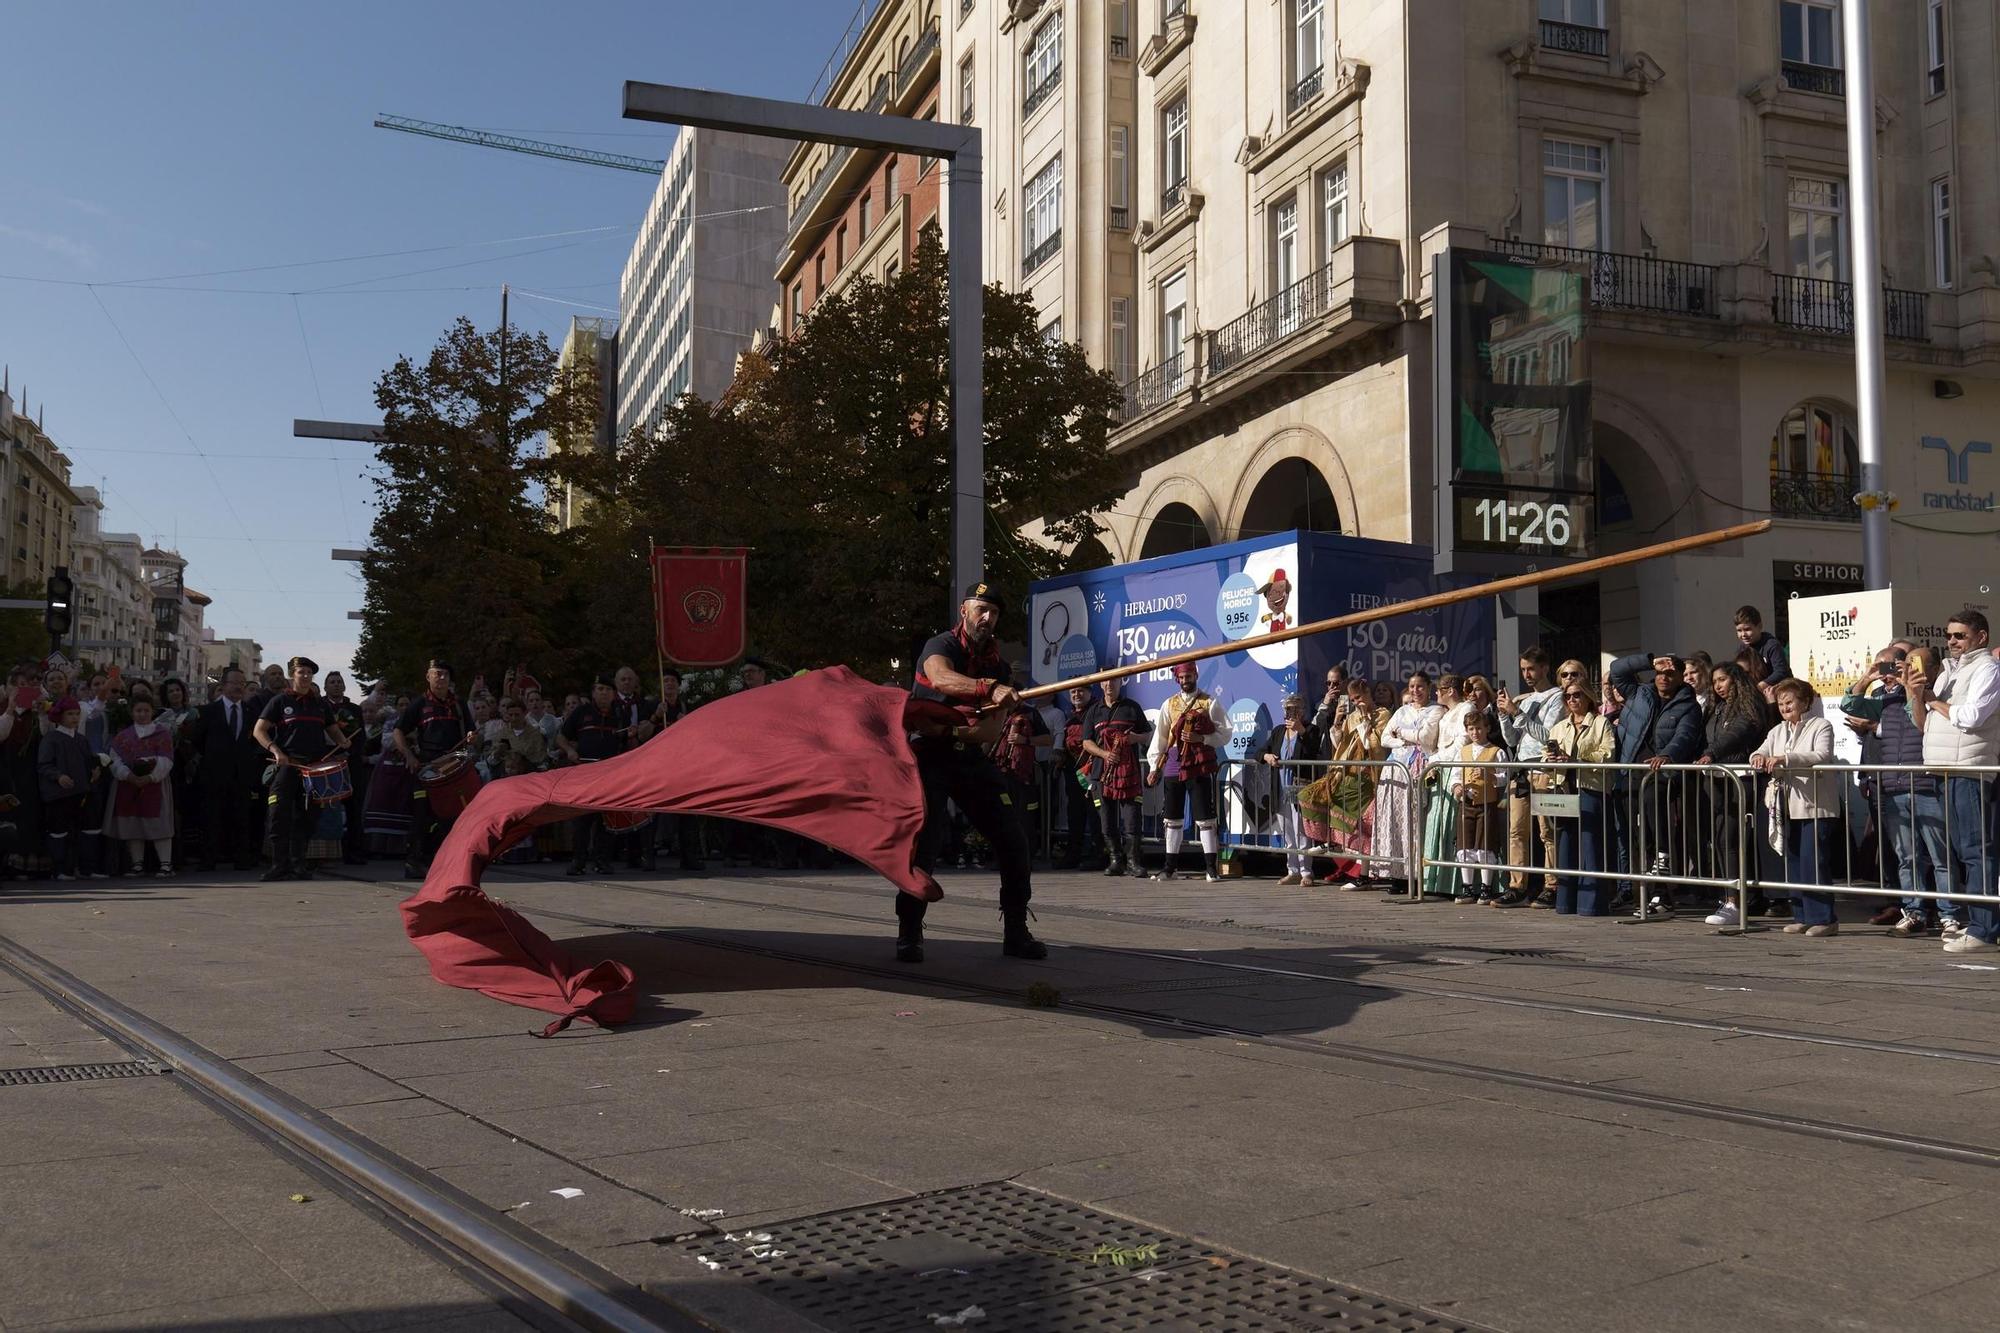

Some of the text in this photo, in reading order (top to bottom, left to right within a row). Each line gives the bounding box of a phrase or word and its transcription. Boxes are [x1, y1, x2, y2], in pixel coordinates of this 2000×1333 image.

[1923, 489, 1994, 512] randstad
[1475, 499, 1570, 546] 11:26
[1793, 563, 1864, 580] SEPHOR
[1222, 587, 1254, 600] PELUCHE
[1124, 596, 1174, 617] HERALDO
[1223, 598, 1252, 610] MORICO
[1226, 612, 1249, 626] 9,95€
[1820, 611, 1855, 628] Pilar
[1347, 619, 1448, 654] 130 años
[1826, 629, 1850, 640] 2025
[1906, 622, 1948, 637] Fiestas
[1117, 625, 1195, 657] 130 años
[1340, 649, 1364, 679] de
[1233, 712, 1257, 722] LIBRO
[1233, 737, 1257, 749] 9,95€
